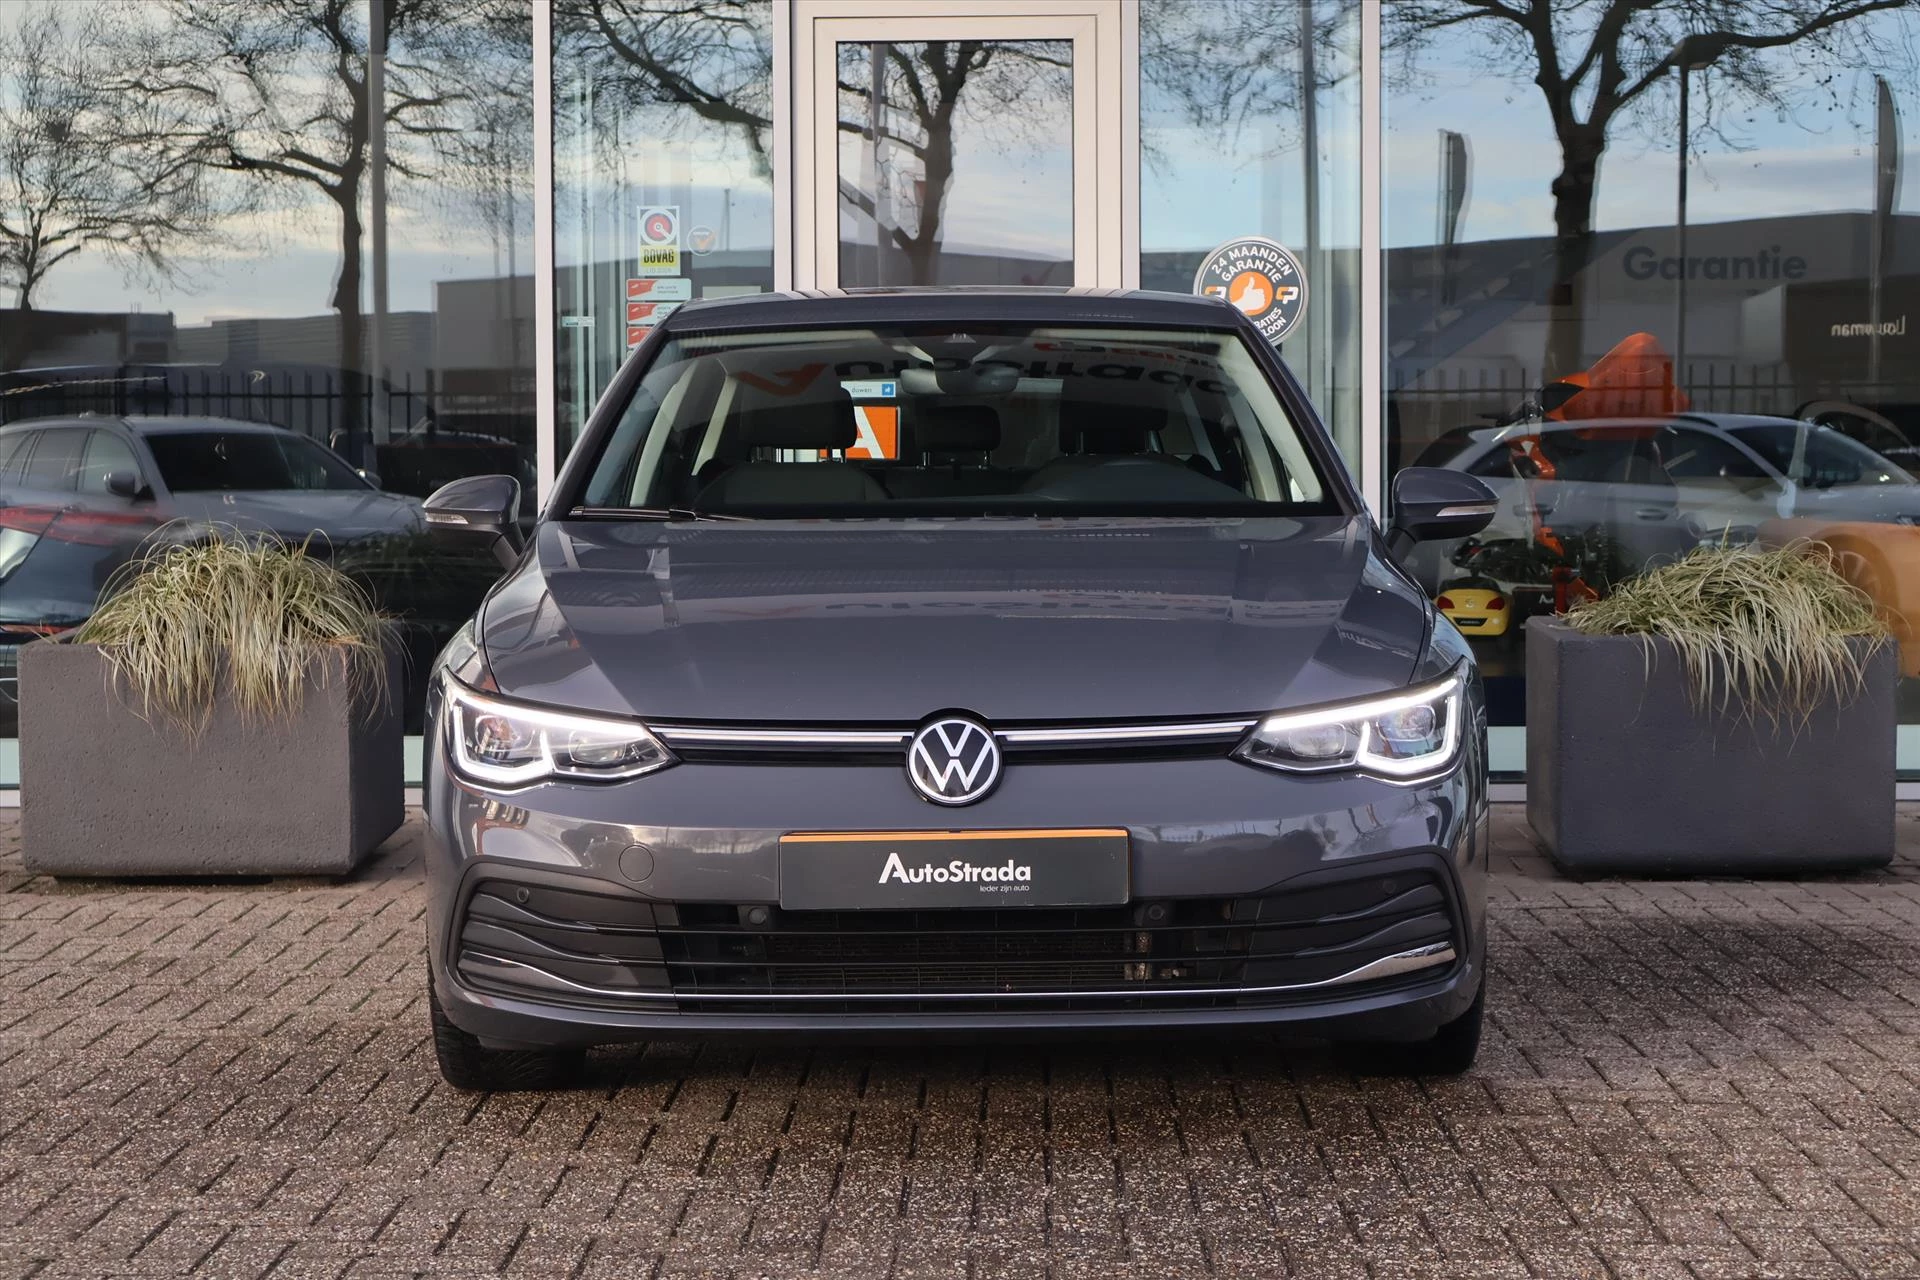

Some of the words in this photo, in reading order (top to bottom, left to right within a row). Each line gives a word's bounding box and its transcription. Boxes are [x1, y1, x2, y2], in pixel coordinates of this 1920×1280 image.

[643, 249, 675, 264] BOVAG
[1211, 257, 1228, 275] 24
[1227, 245, 1293, 277] MAANDEN
[1221, 258, 1283, 284] GARANTIE
[1623, 244, 1807, 281] Garantie
[878, 852, 1031, 884] AutoStrada
[1013, 884, 1030, 892] auto
